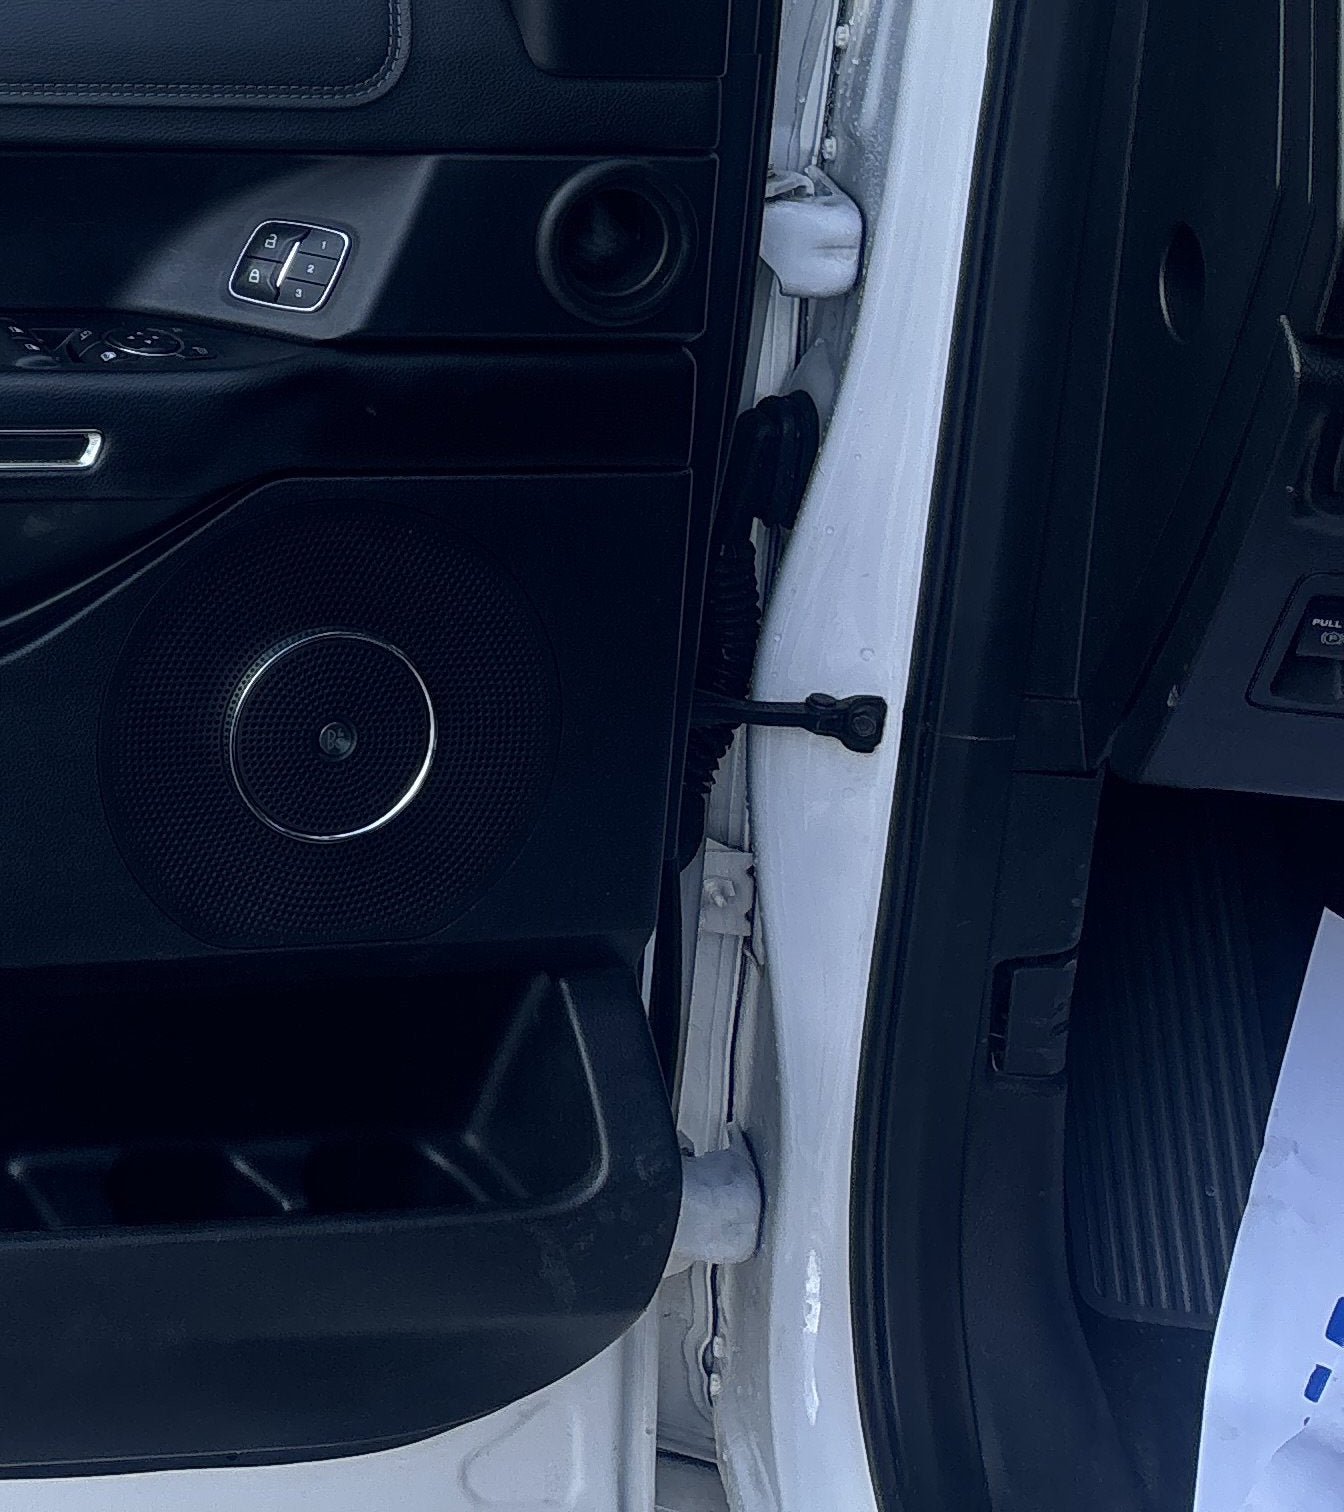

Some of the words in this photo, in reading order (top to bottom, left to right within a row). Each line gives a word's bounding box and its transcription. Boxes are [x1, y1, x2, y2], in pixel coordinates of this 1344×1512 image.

[321, 241, 327, 249] 1
[307, 265, 315, 273] 2
[295, 289, 302, 297] 3
[1313, 618, 1342, 629] PULL
